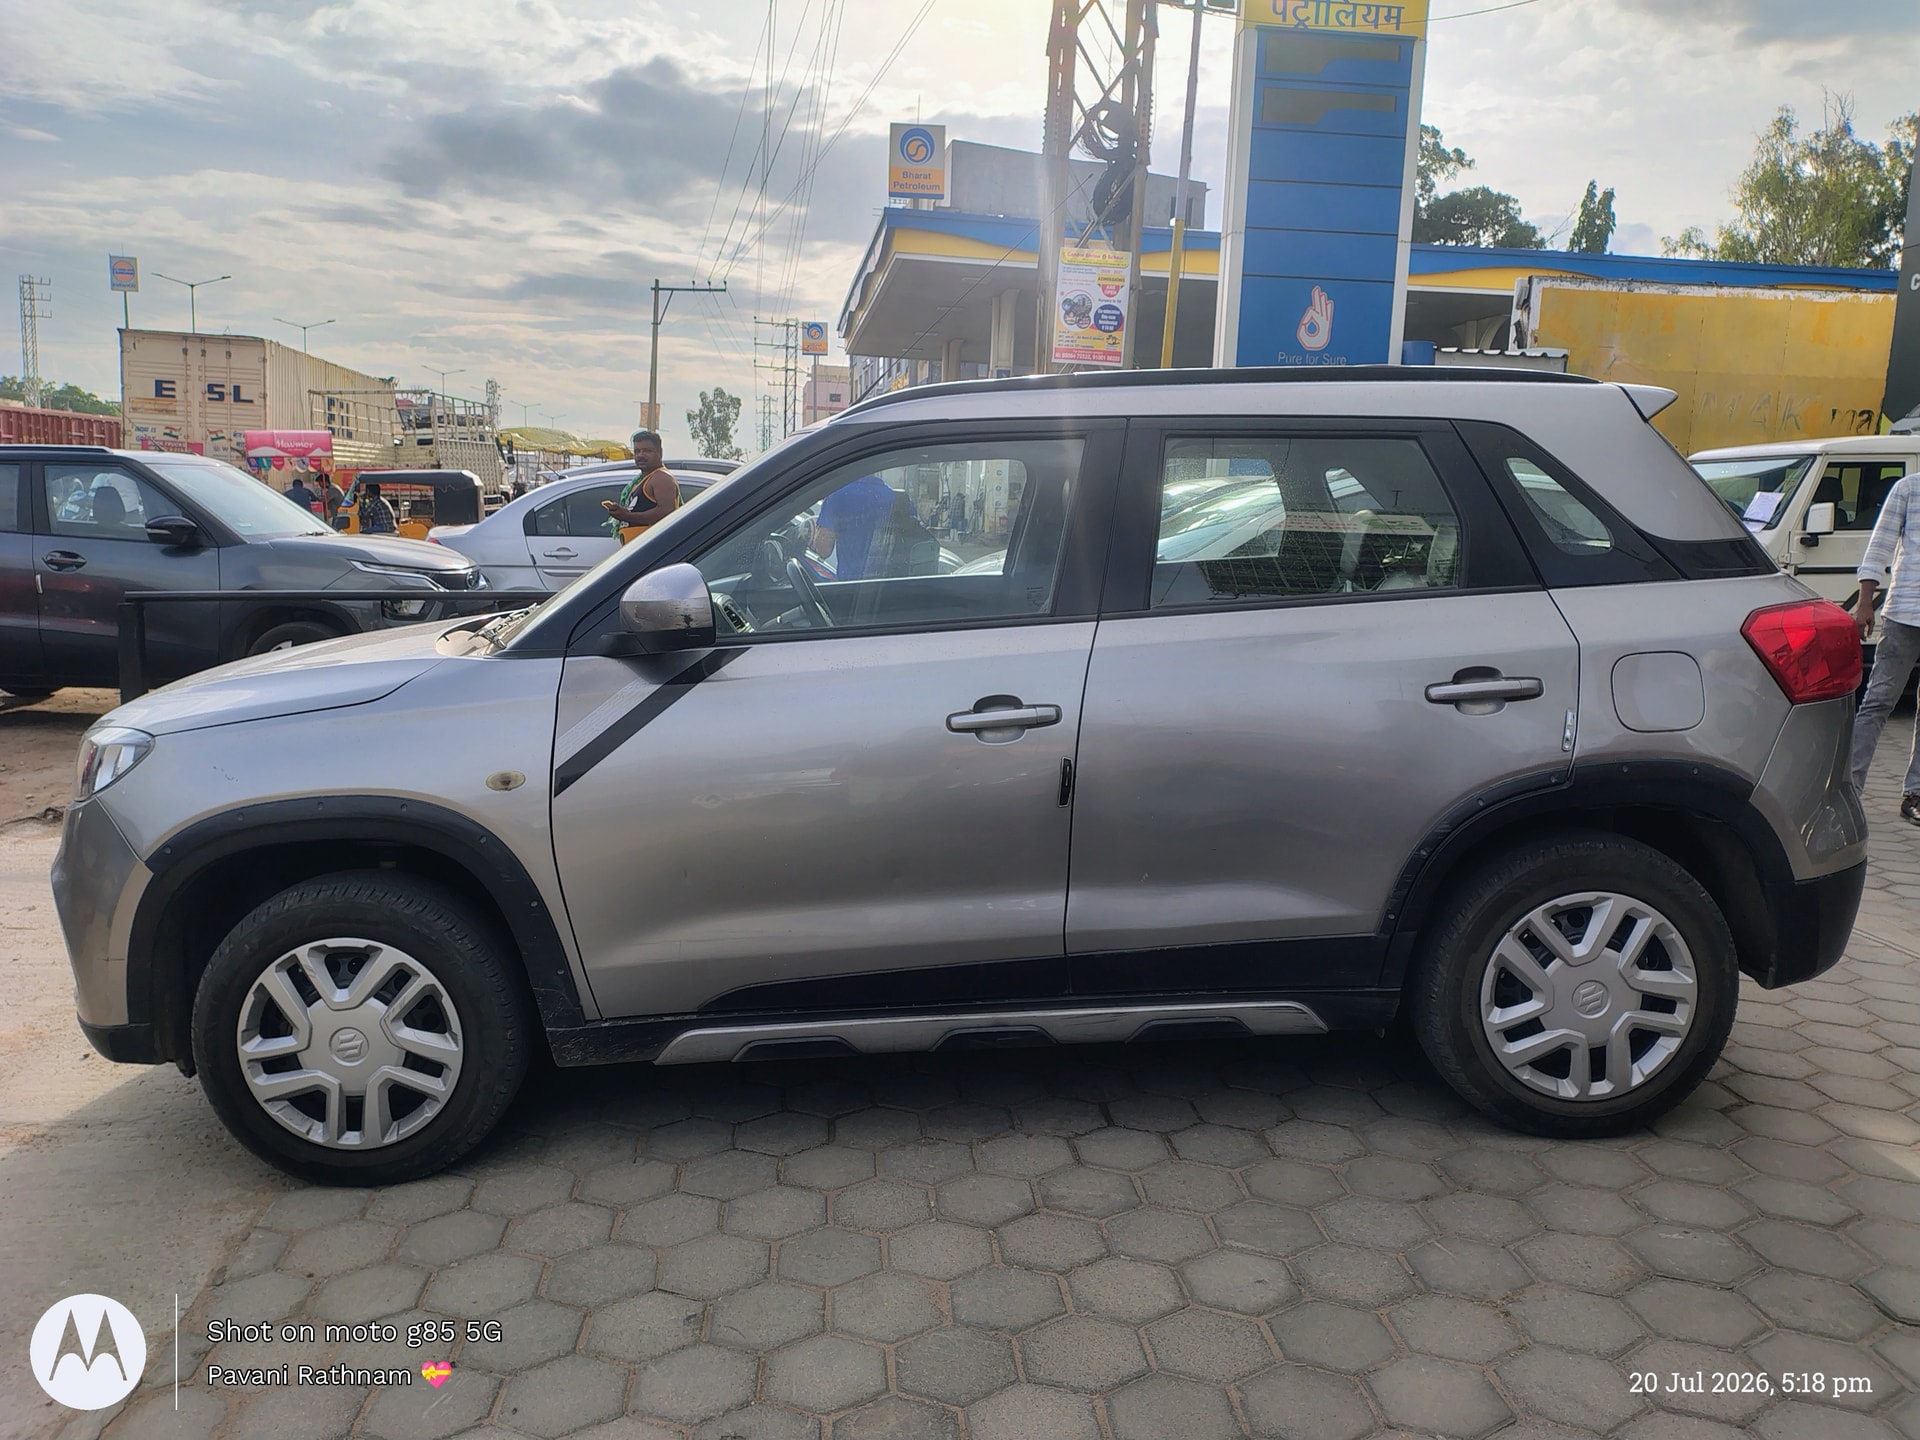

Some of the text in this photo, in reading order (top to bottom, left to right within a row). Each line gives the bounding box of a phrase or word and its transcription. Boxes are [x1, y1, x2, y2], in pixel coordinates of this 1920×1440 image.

[902, 171, 931, 180] Bharat
[893, 181, 941, 191] Petroleum
[1278, 351, 1347, 366] Pure for Sure
[276, 439, 314, 449] Havmor
